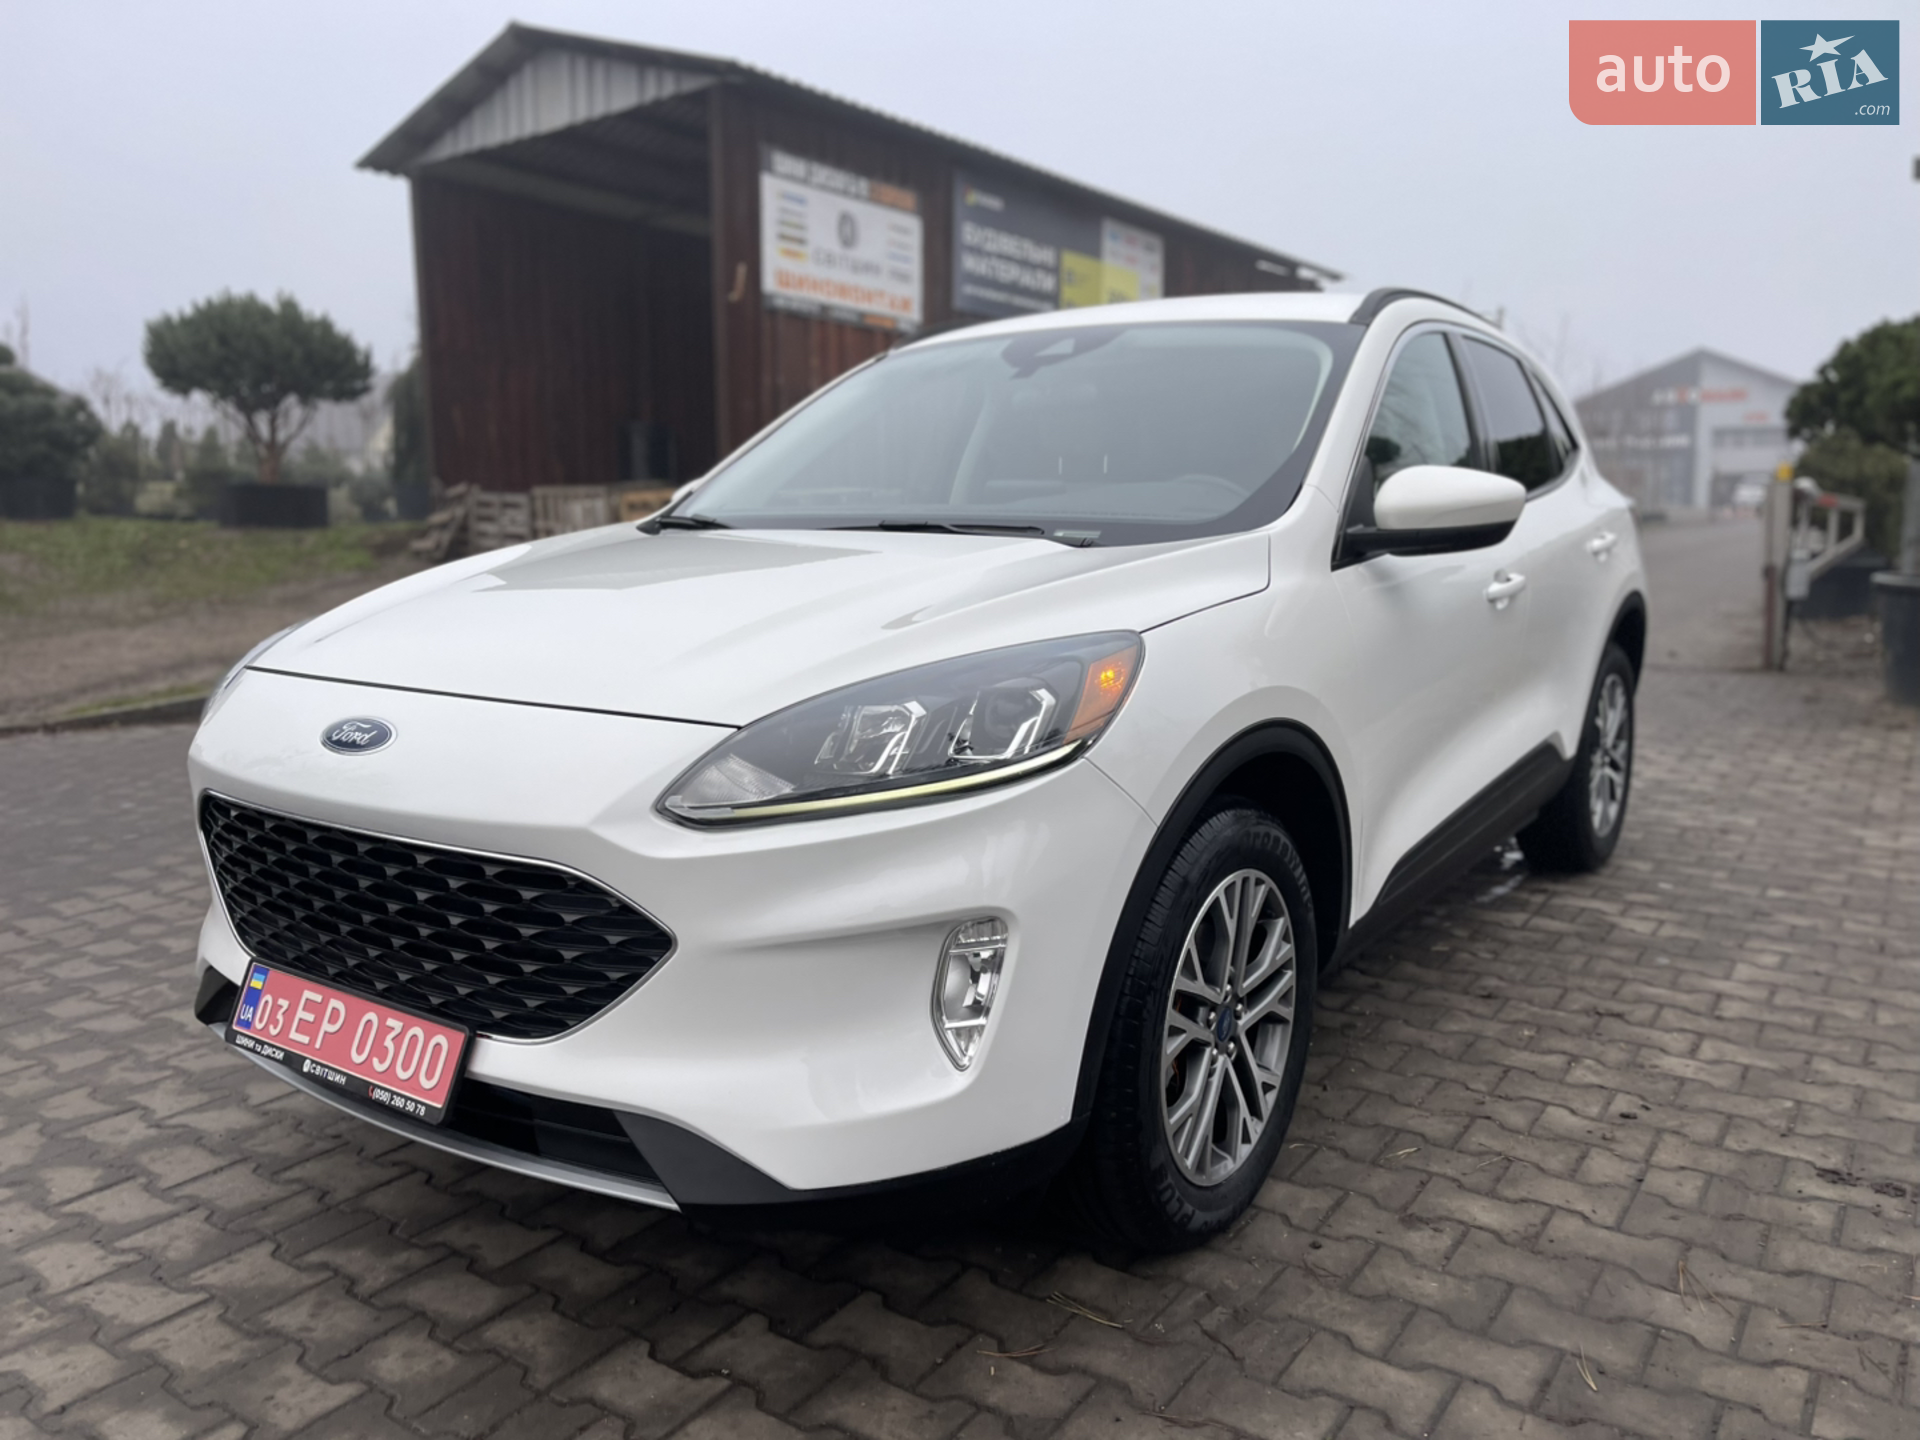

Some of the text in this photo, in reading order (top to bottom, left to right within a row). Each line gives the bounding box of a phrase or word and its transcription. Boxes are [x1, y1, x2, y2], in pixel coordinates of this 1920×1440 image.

[331, 720, 378, 746] Ford
[240, 1003, 254, 1023] UA
[350, 1011, 449, 1090] 0300
[309, 1063, 347, 1086] СВІТШИН
[372, 1087, 391, 1105] (050)
[405, 1100, 416, 1112] 50
